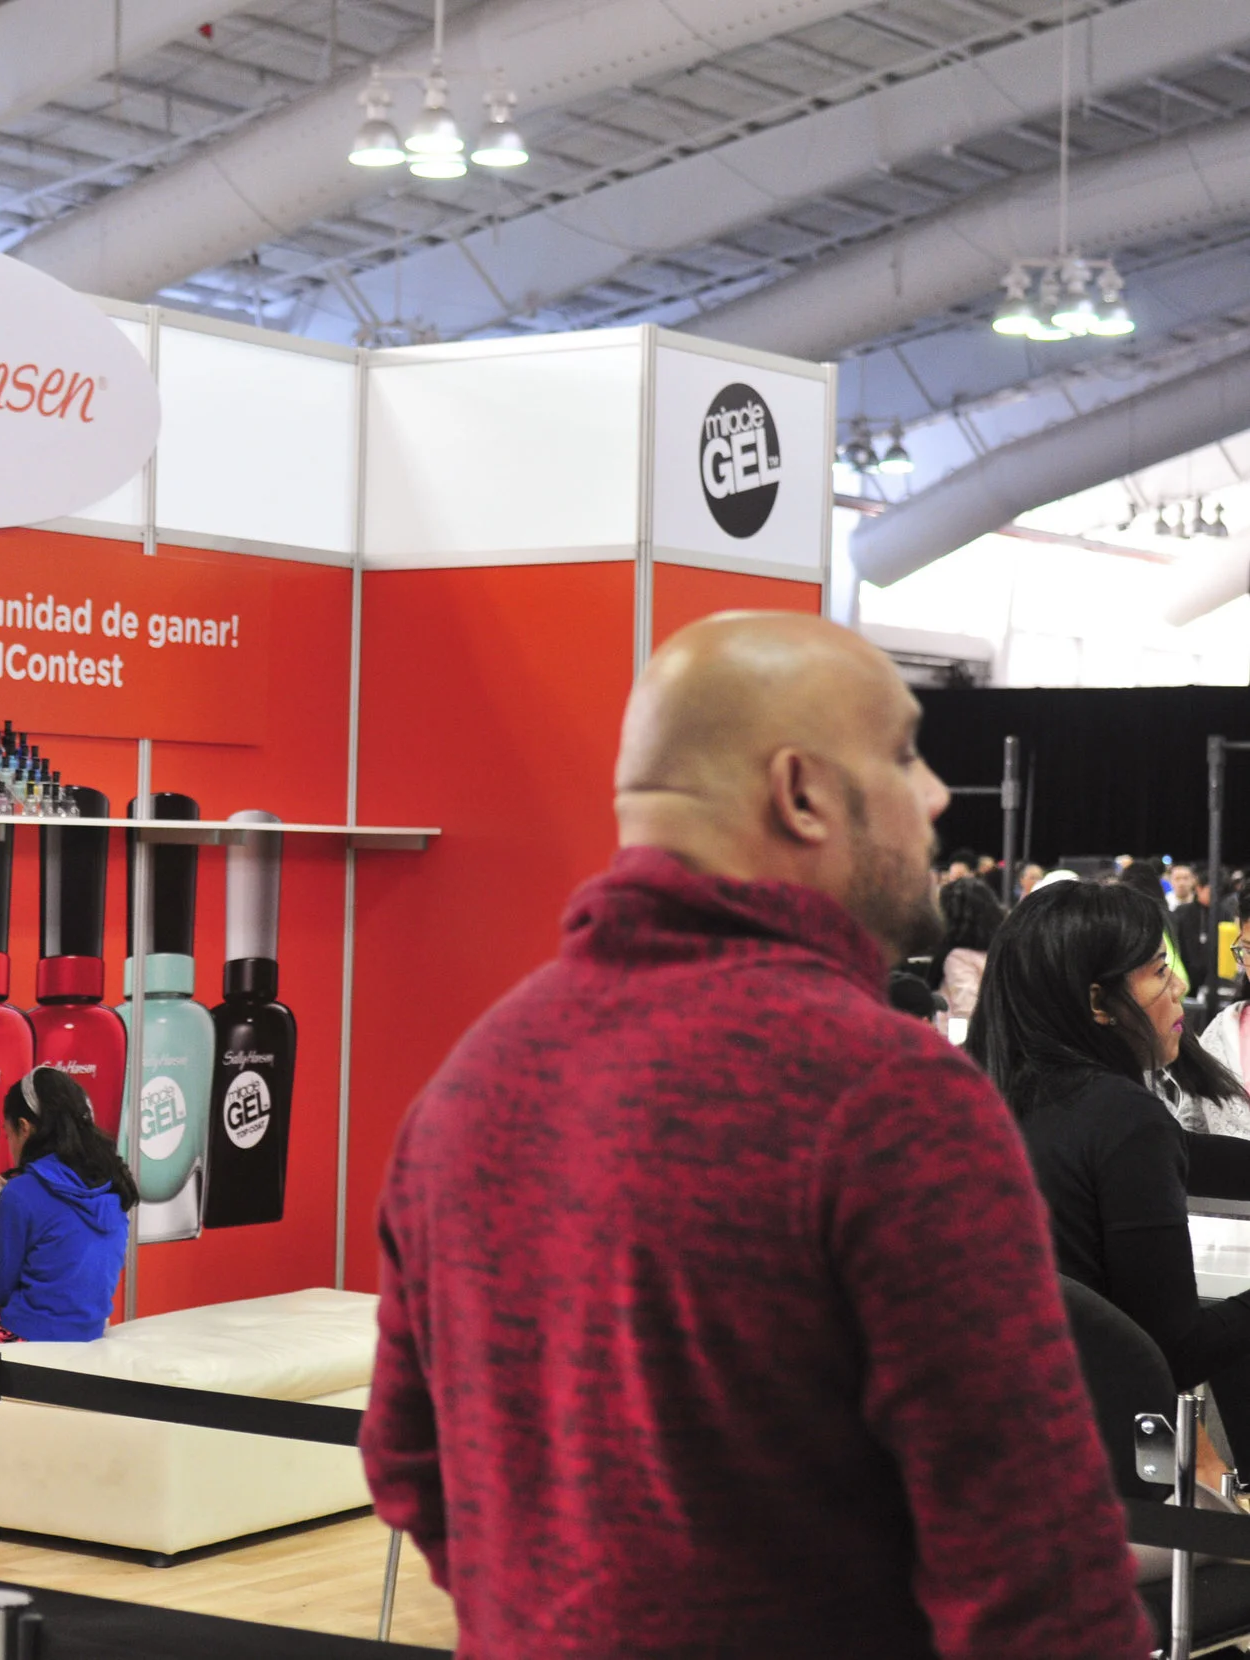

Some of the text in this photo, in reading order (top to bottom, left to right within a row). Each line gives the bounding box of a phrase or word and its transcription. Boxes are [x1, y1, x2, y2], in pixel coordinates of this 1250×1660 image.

[705, 400, 765, 440] miracle
[702, 427, 781, 499] GEL
[101, 601, 140, 639] de
[148, 613, 240, 649] ganar!
[141, 1098, 186, 1140] GEL
[227, 1092, 271, 1131] GEL
